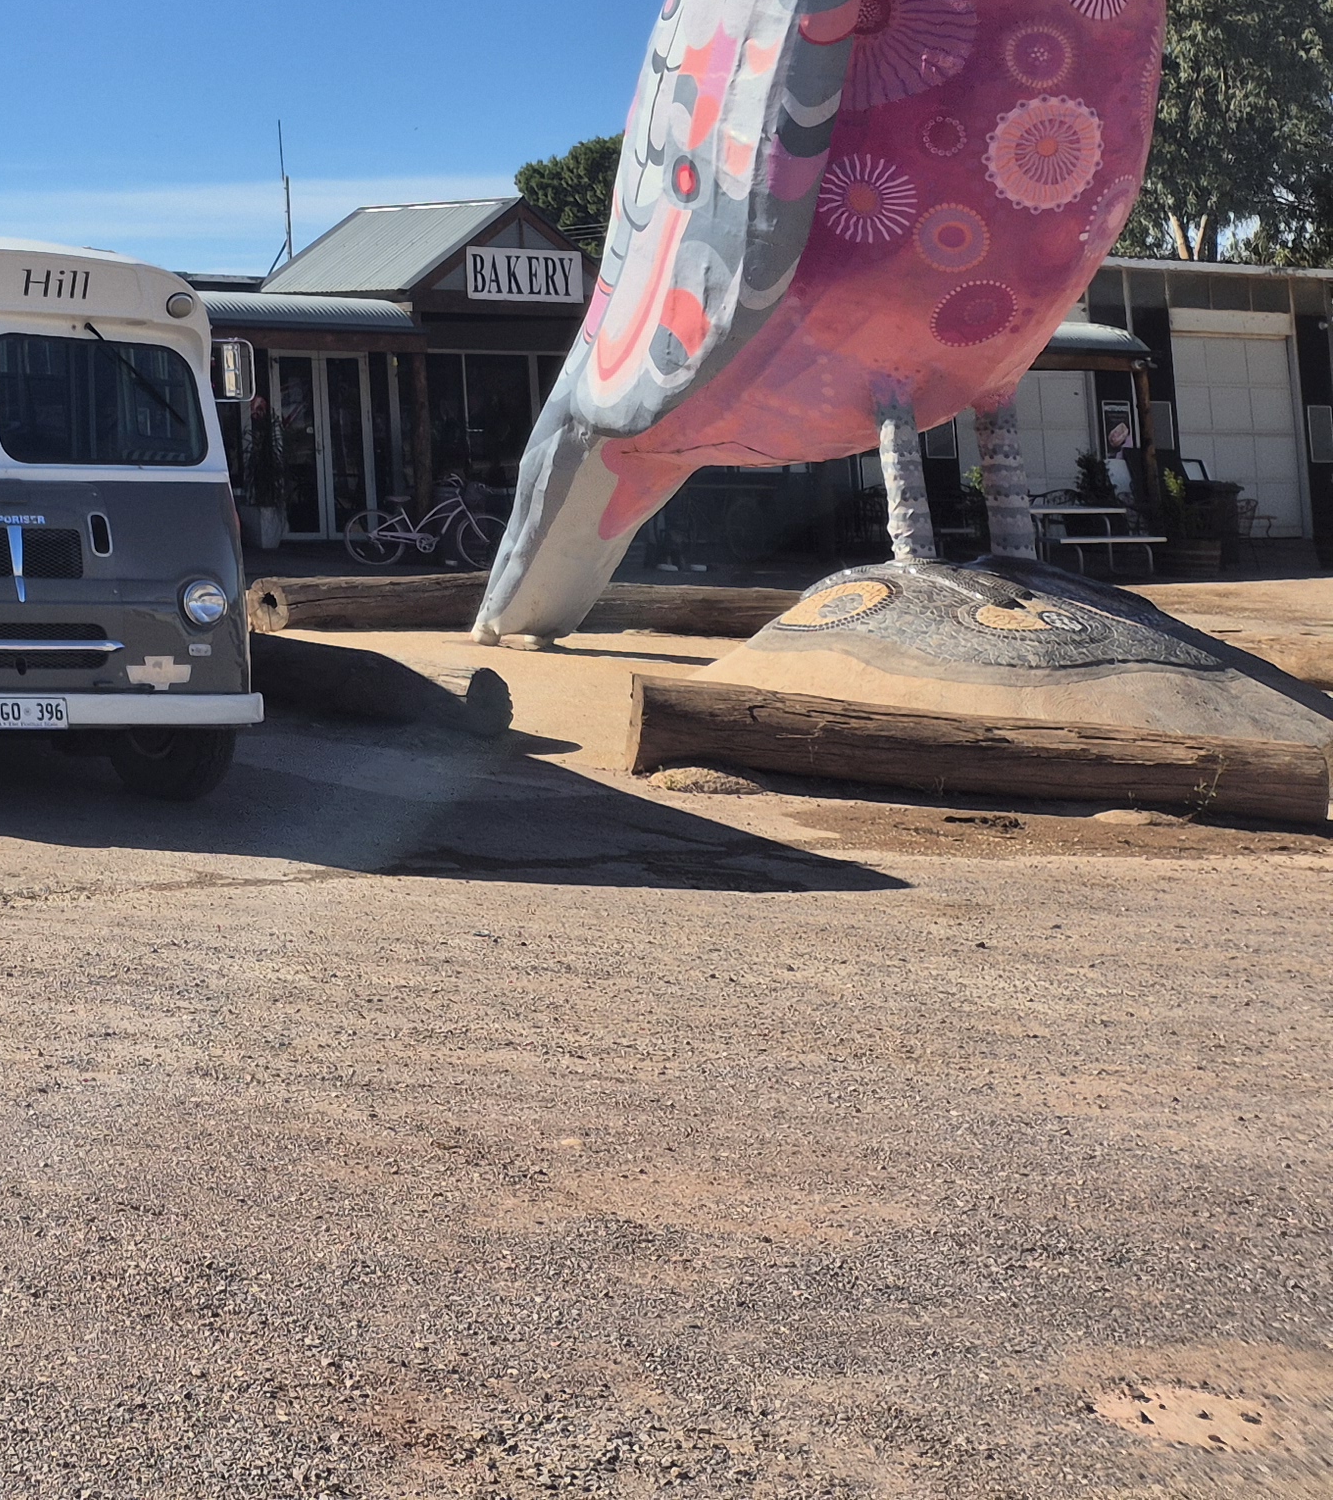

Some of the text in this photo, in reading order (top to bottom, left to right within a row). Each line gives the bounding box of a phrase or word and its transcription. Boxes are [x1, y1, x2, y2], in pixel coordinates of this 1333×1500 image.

[22, 268, 90, 300] Hill
[471, 253, 574, 297] BAKERY
[36, 702, 64, 721] 396
